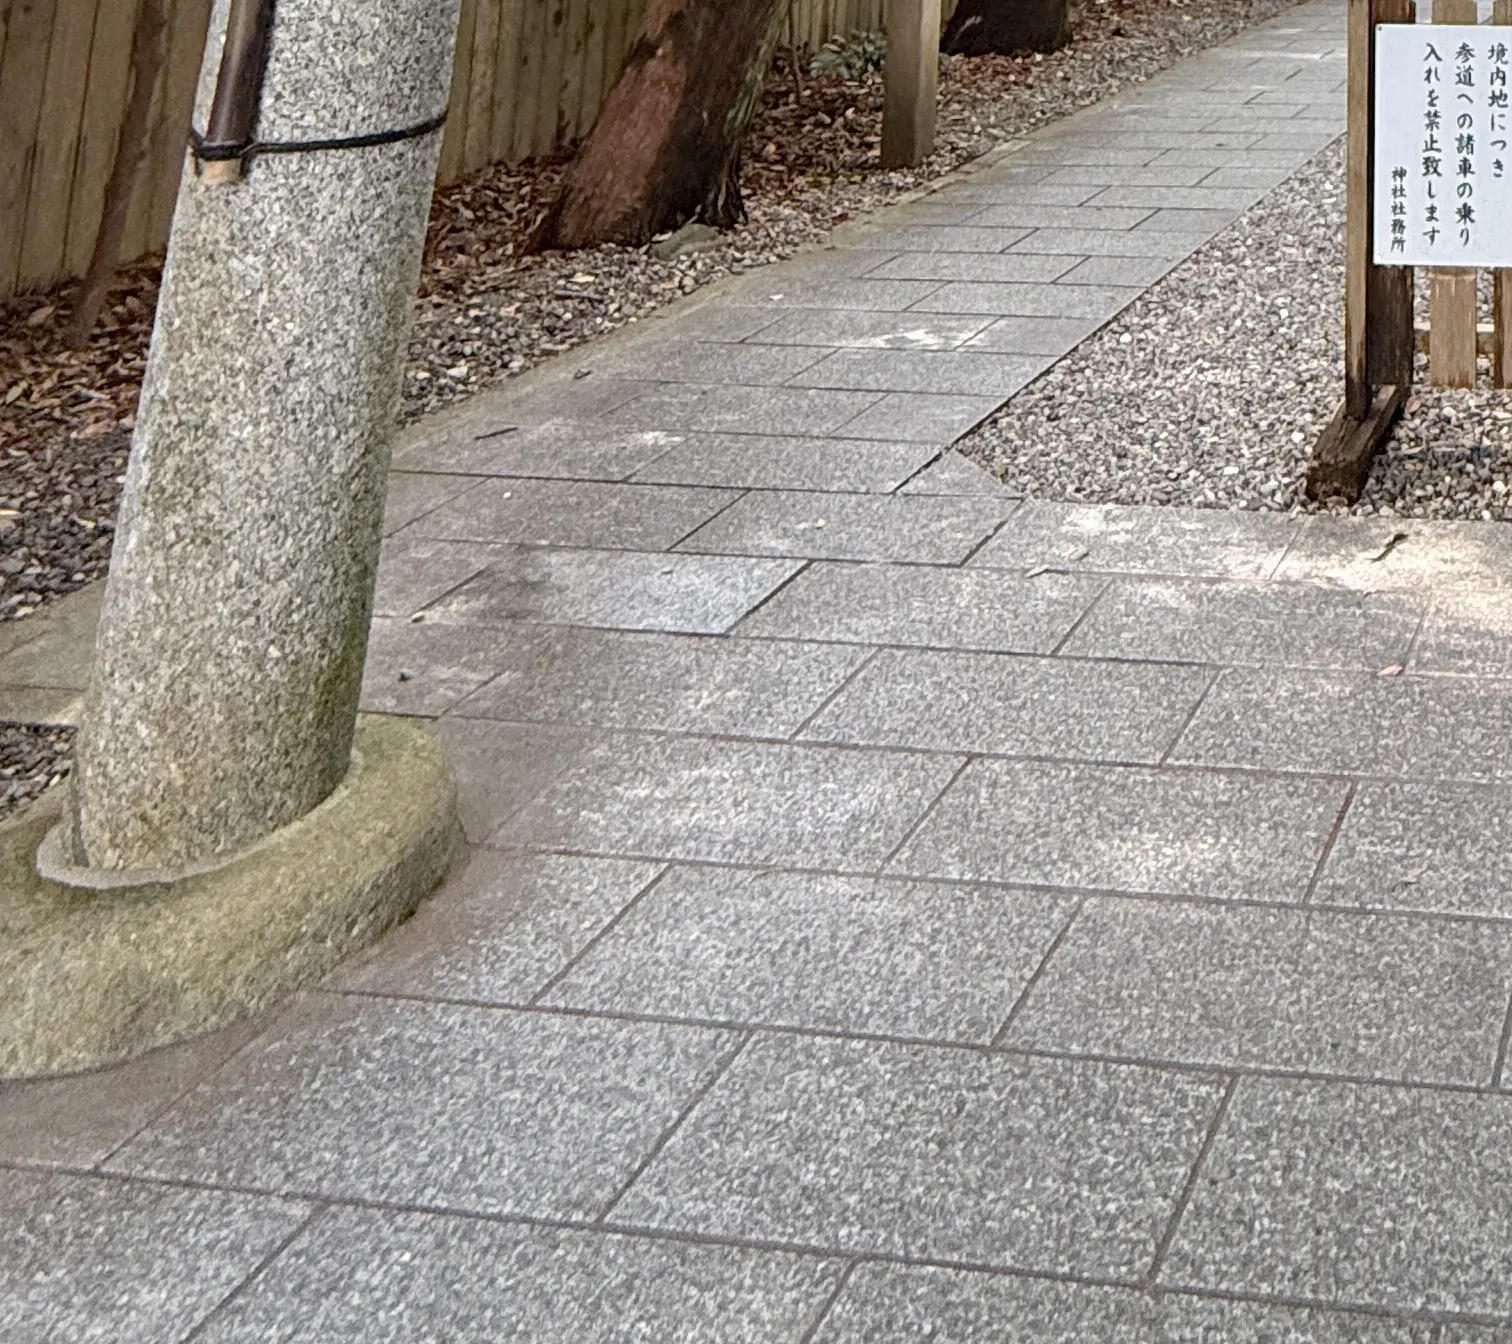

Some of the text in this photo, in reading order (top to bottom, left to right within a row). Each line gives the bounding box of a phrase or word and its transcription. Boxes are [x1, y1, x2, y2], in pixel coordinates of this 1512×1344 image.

[1421, 41, 1443, 247] 入れを禁止致します
[1454, 41, 1476, 247] 参道への諸車の乗り
[1487, 41, 1509, 179] 境内地につき
[1390, 165, 1408, 254] 神社社務所
